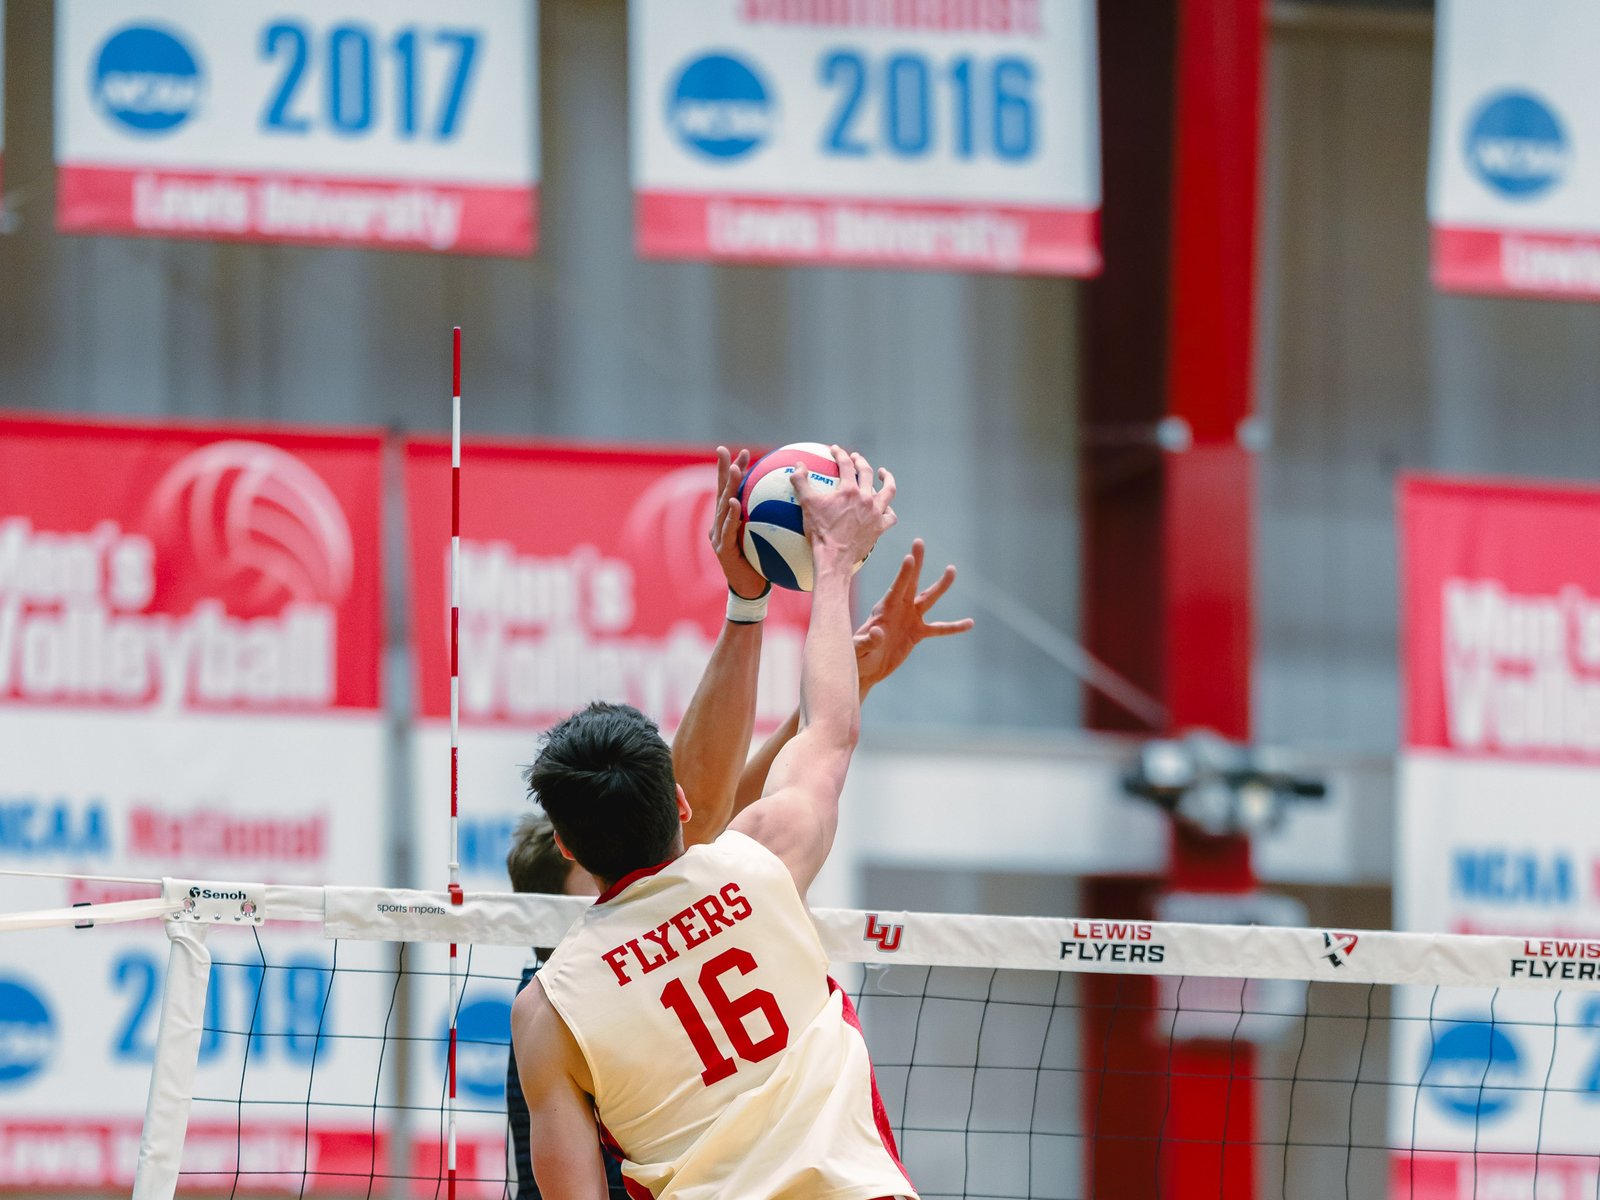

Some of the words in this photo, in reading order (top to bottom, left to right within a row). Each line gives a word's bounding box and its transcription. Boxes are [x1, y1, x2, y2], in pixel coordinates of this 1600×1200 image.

[258, 20, 484, 140] 2017
[818, 48, 1038, 164] 2016
[132, 172, 247, 233] Lewis
[260, 181, 462, 249] University
[706, 200, 818, 254] Lewis
[830, 207, 1028, 270] University
[447, 542, 634, 634] Men's
[130, 807, 327, 862] National
[202, 889, 247, 900] Senoh
[377, 903, 408, 914] sports
[409, 906, 446, 915] imports
[601, 882, 752, 987] FLYERS
[864, 913, 904, 953] LU
[1060, 941, 1165, 963] FLYERS
[1073, 922, 1152, 941] LEWIS
[1524, 940, 1600, 958] LEWIS
[1510, 959, 1600, 980] FLYER
[660, 947, 789, 1087] 16
